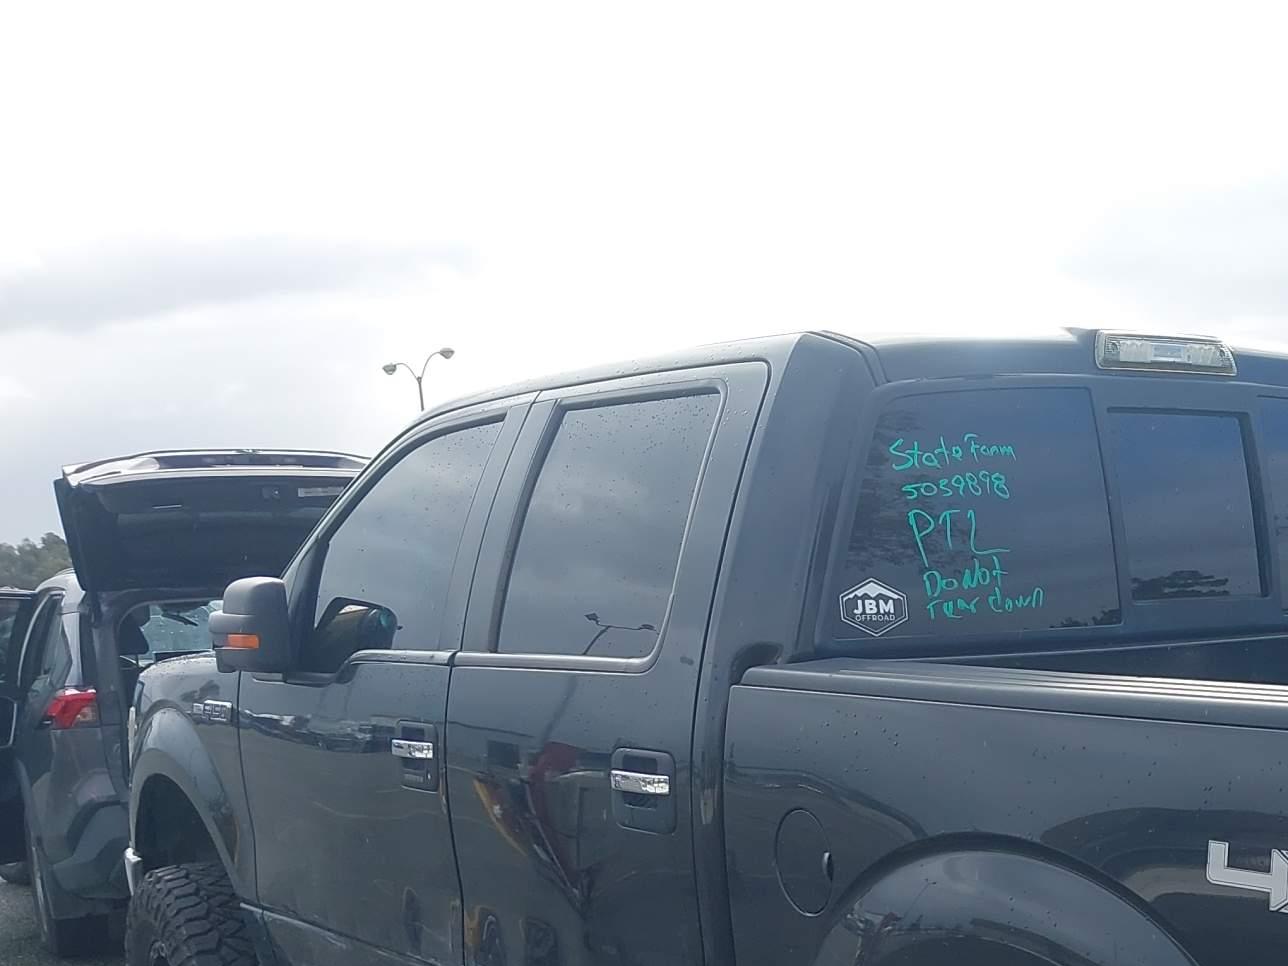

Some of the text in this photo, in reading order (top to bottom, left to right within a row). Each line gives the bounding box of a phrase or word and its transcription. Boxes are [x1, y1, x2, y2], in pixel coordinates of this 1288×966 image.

[889, 436, 963, 471] State
[853, 599, 895, 615] JBM
[855, 614, 896, 622] OFFROAD
